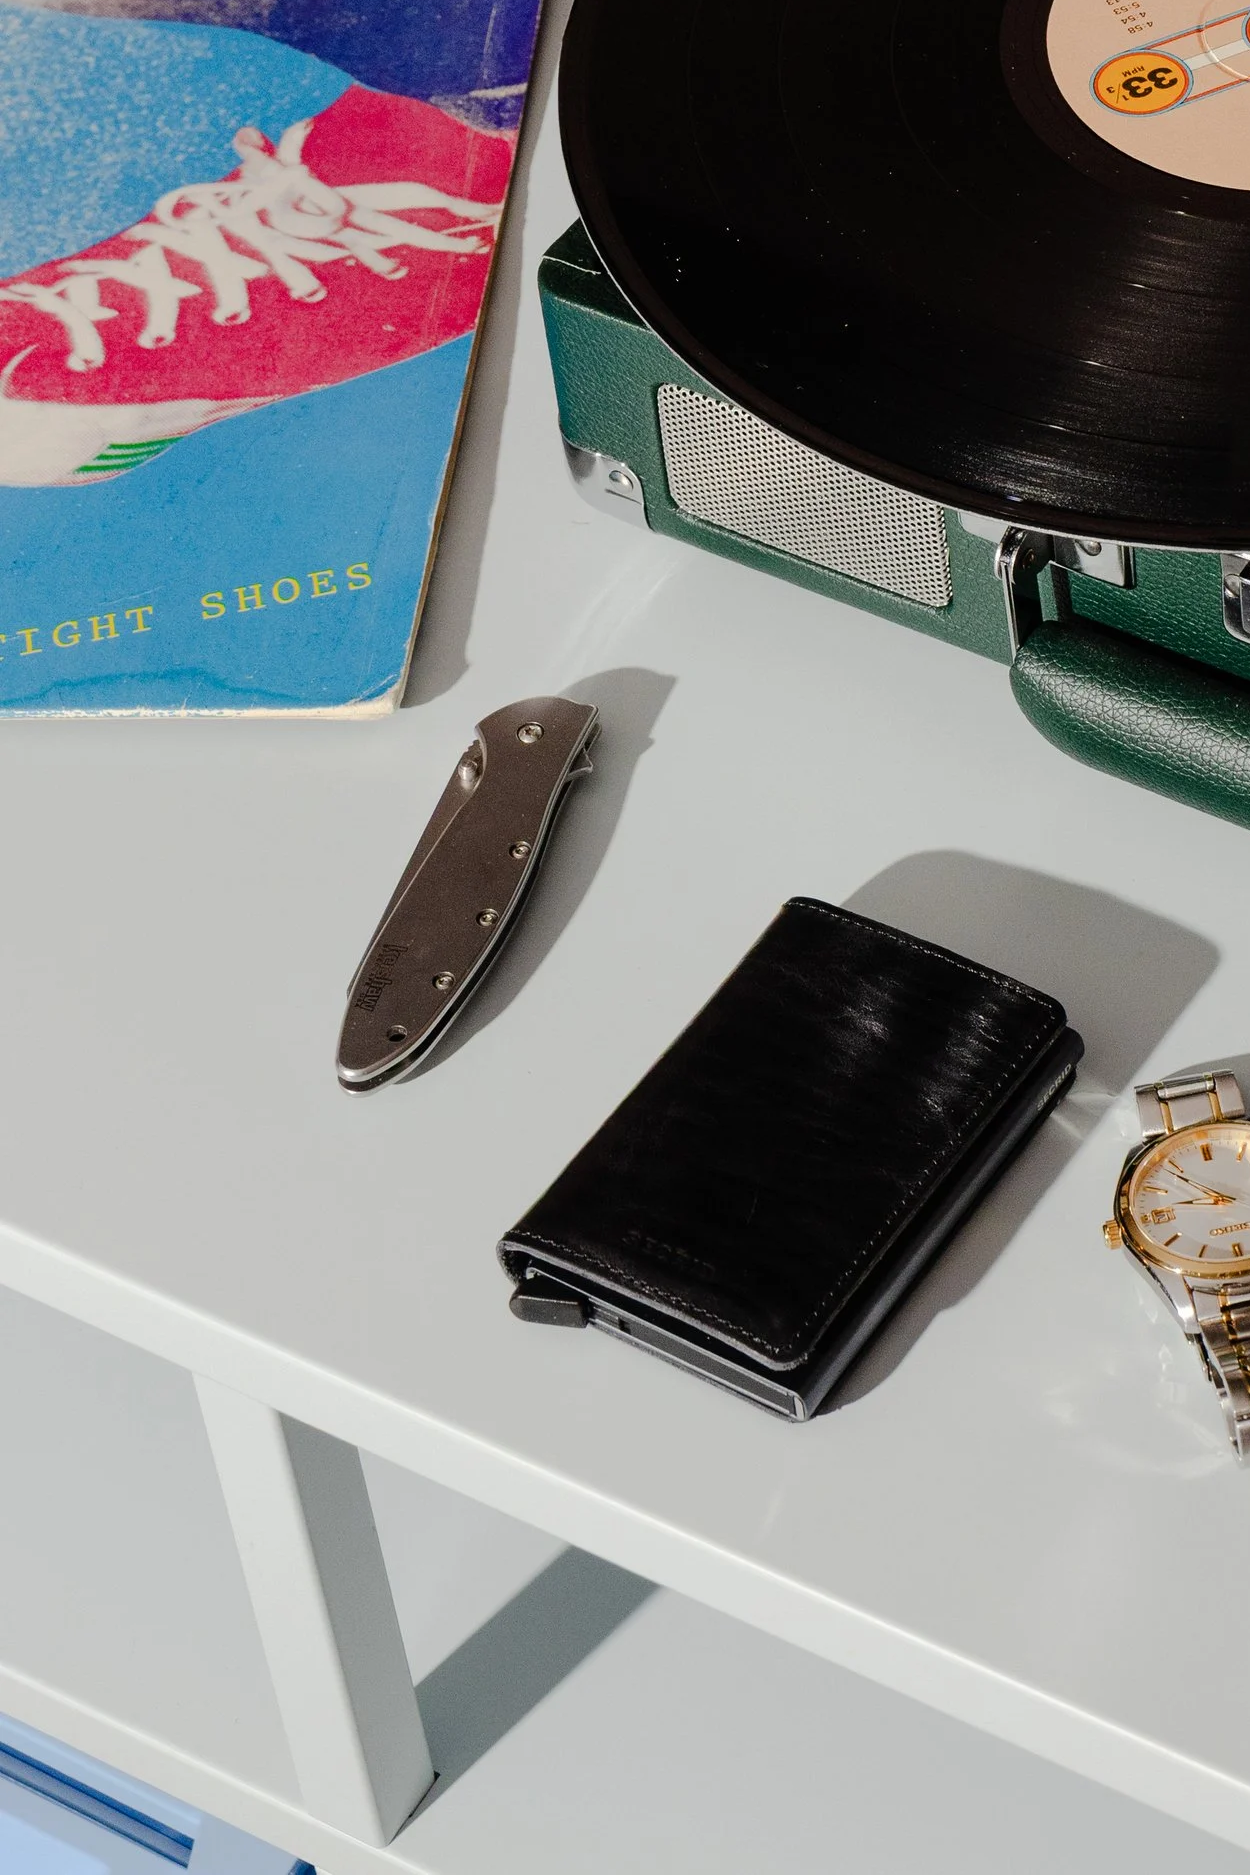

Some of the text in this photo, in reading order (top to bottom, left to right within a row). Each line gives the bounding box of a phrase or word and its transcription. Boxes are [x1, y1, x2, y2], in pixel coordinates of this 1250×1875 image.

[1112, 1, 1140, 15] 5:53
[1120, 10, 1147, 25] 4:54
[1127, 20, 1154, 35] 4:58
[1121, 65, 1145, 77] RPM
[0, 562, 373, 661] IGHT SHOES
[1037, 1062, 1072, 1111] SECRID
